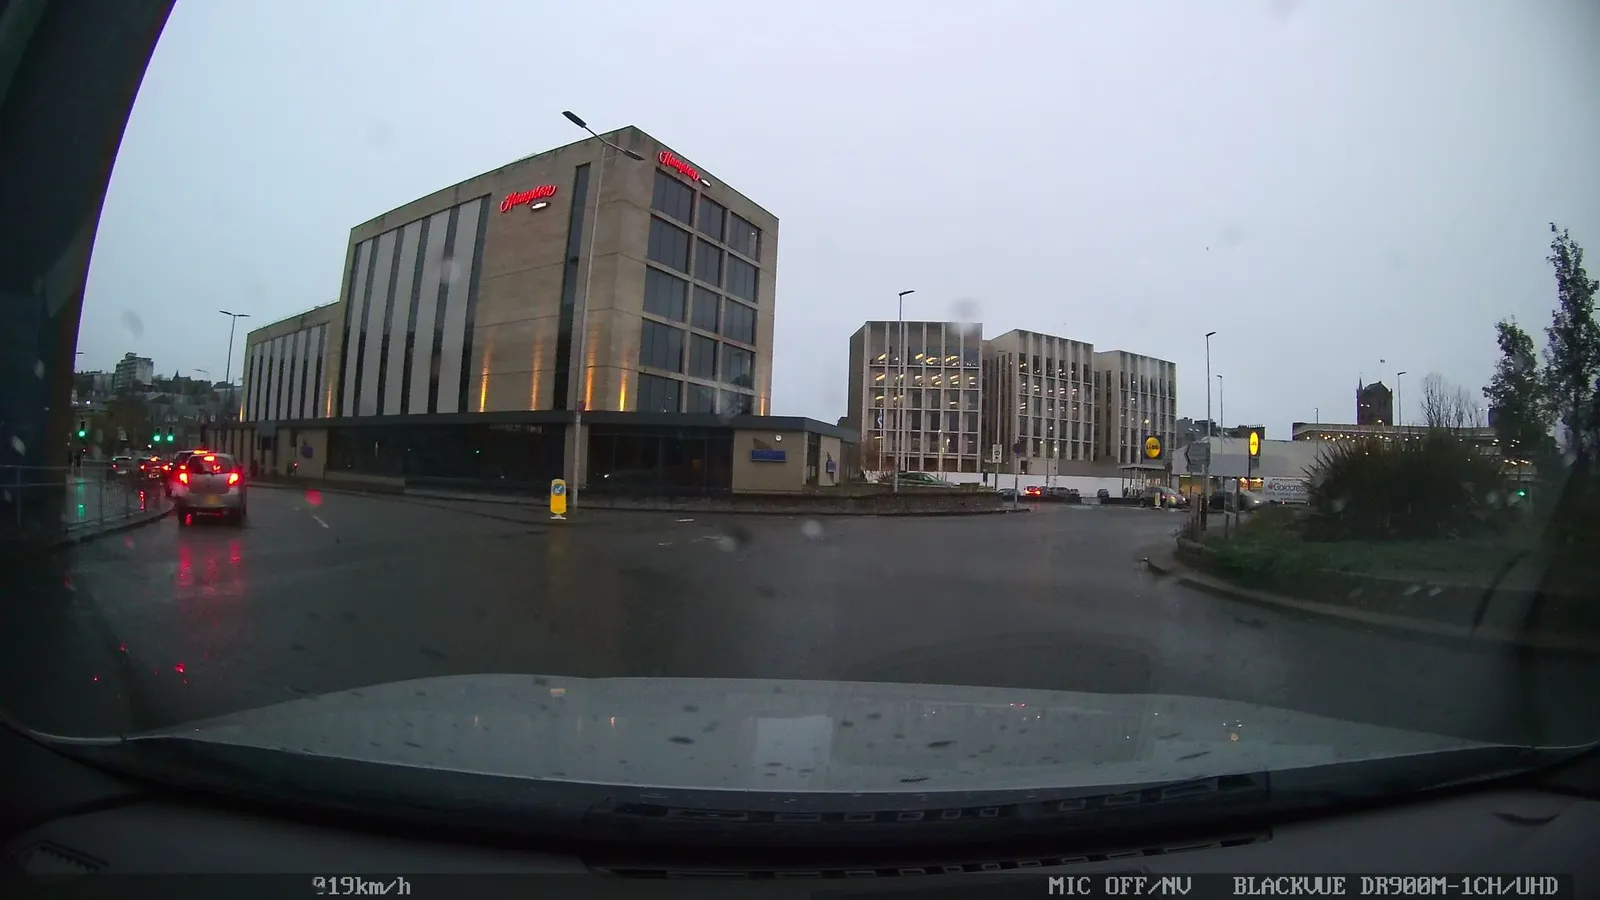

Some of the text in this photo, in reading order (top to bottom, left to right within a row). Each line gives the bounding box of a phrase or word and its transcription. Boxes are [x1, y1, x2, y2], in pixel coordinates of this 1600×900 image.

[659, 150, 700, 181] Hampton
[500, 184, 558, 212] Hampton
[1273, 482, 1308, 492] Goldcres
